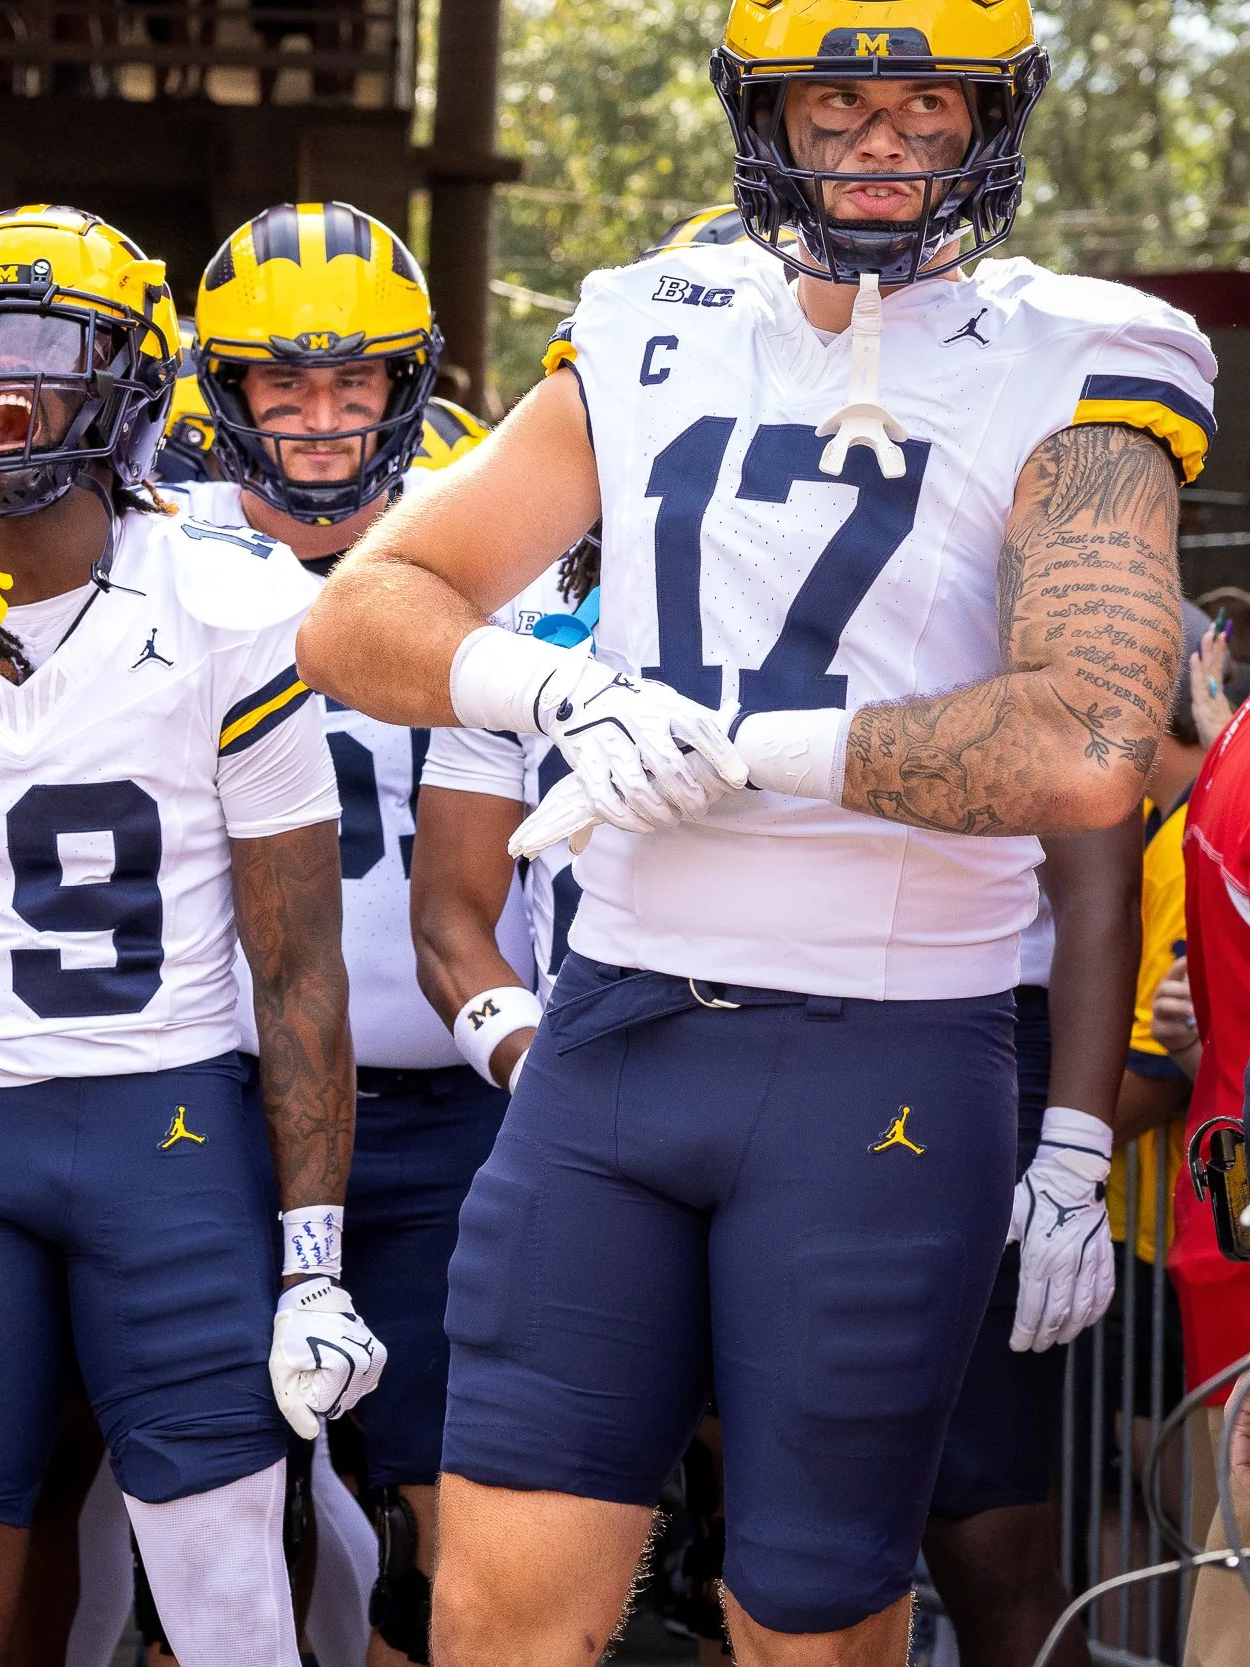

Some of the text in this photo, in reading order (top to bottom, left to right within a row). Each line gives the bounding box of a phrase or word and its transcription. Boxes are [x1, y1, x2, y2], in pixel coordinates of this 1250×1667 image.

[855, 33, 890, 56] M
[309, 334, 330, 350] M
[639, 335, 680, 387] C
[1090, 534, 1106, 544] in
[1108, 531, 1131, 549] the
[640, 415, 933, 711] 17
[1075, 667, 1147, 712] PROVERBS
[467, 998, 501, 1032] M
